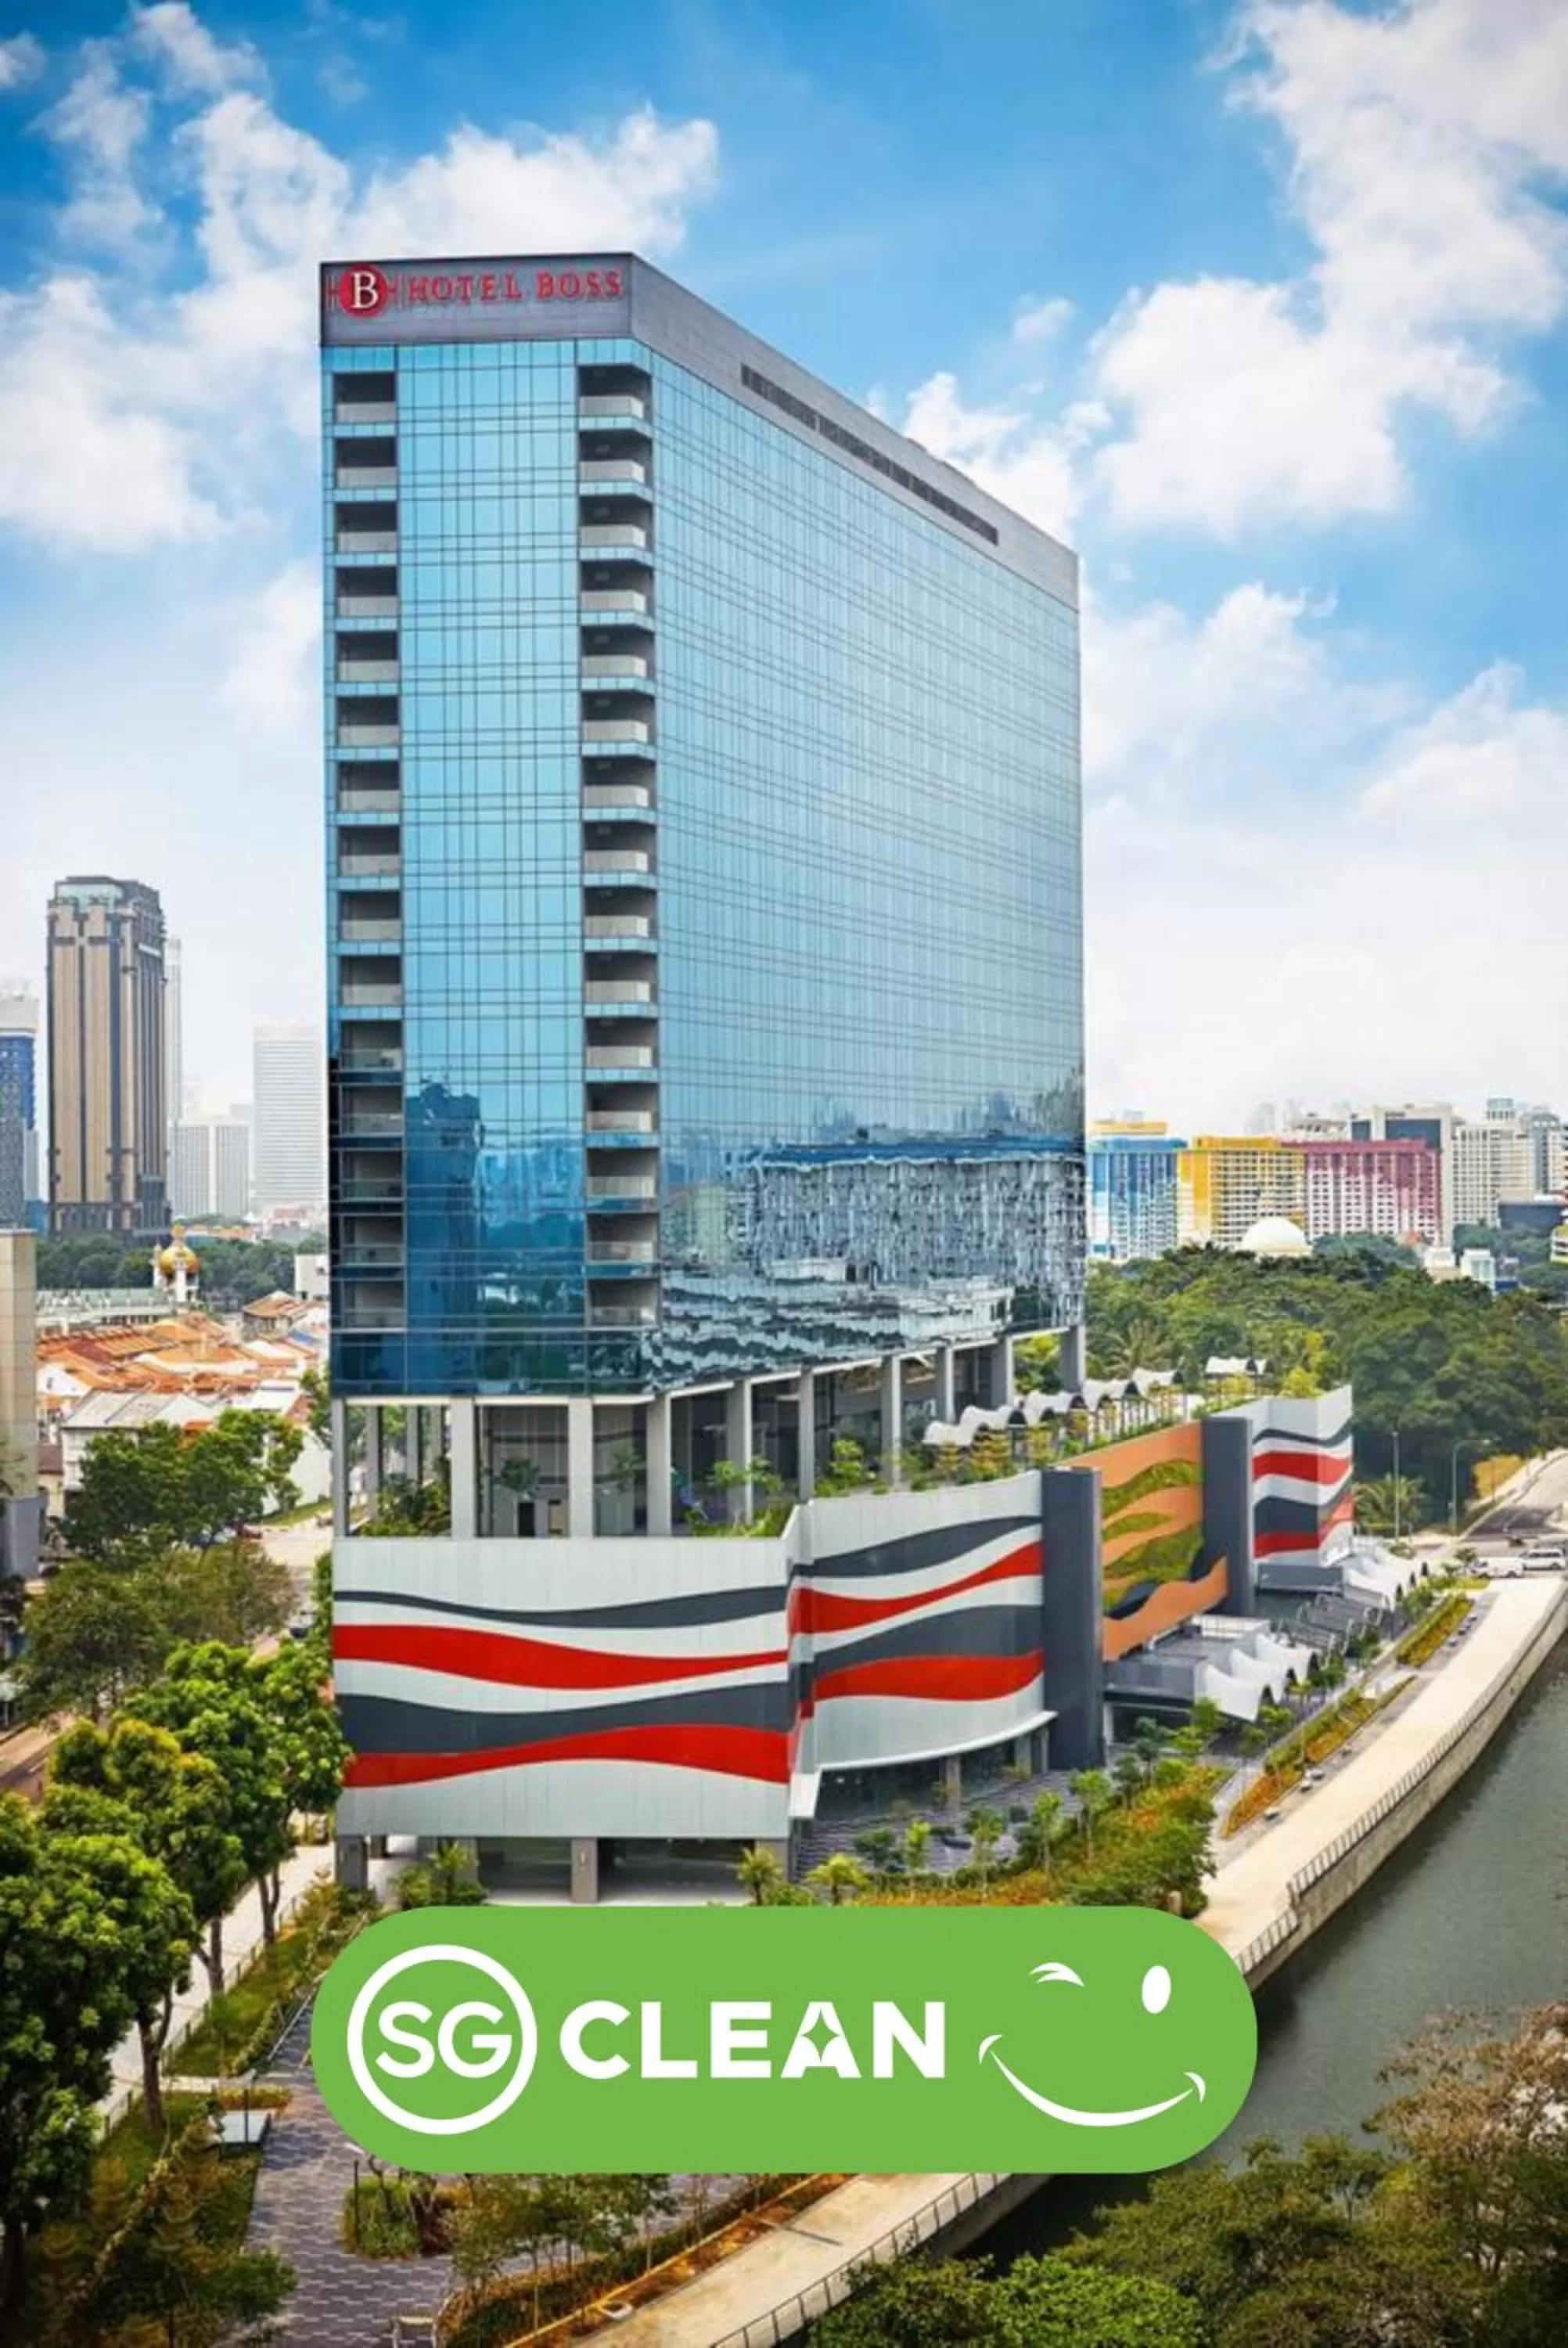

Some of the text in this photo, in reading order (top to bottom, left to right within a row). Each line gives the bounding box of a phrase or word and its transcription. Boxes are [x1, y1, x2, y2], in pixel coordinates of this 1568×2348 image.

[351, 268, 623, 309] B HOTEL BOSS
